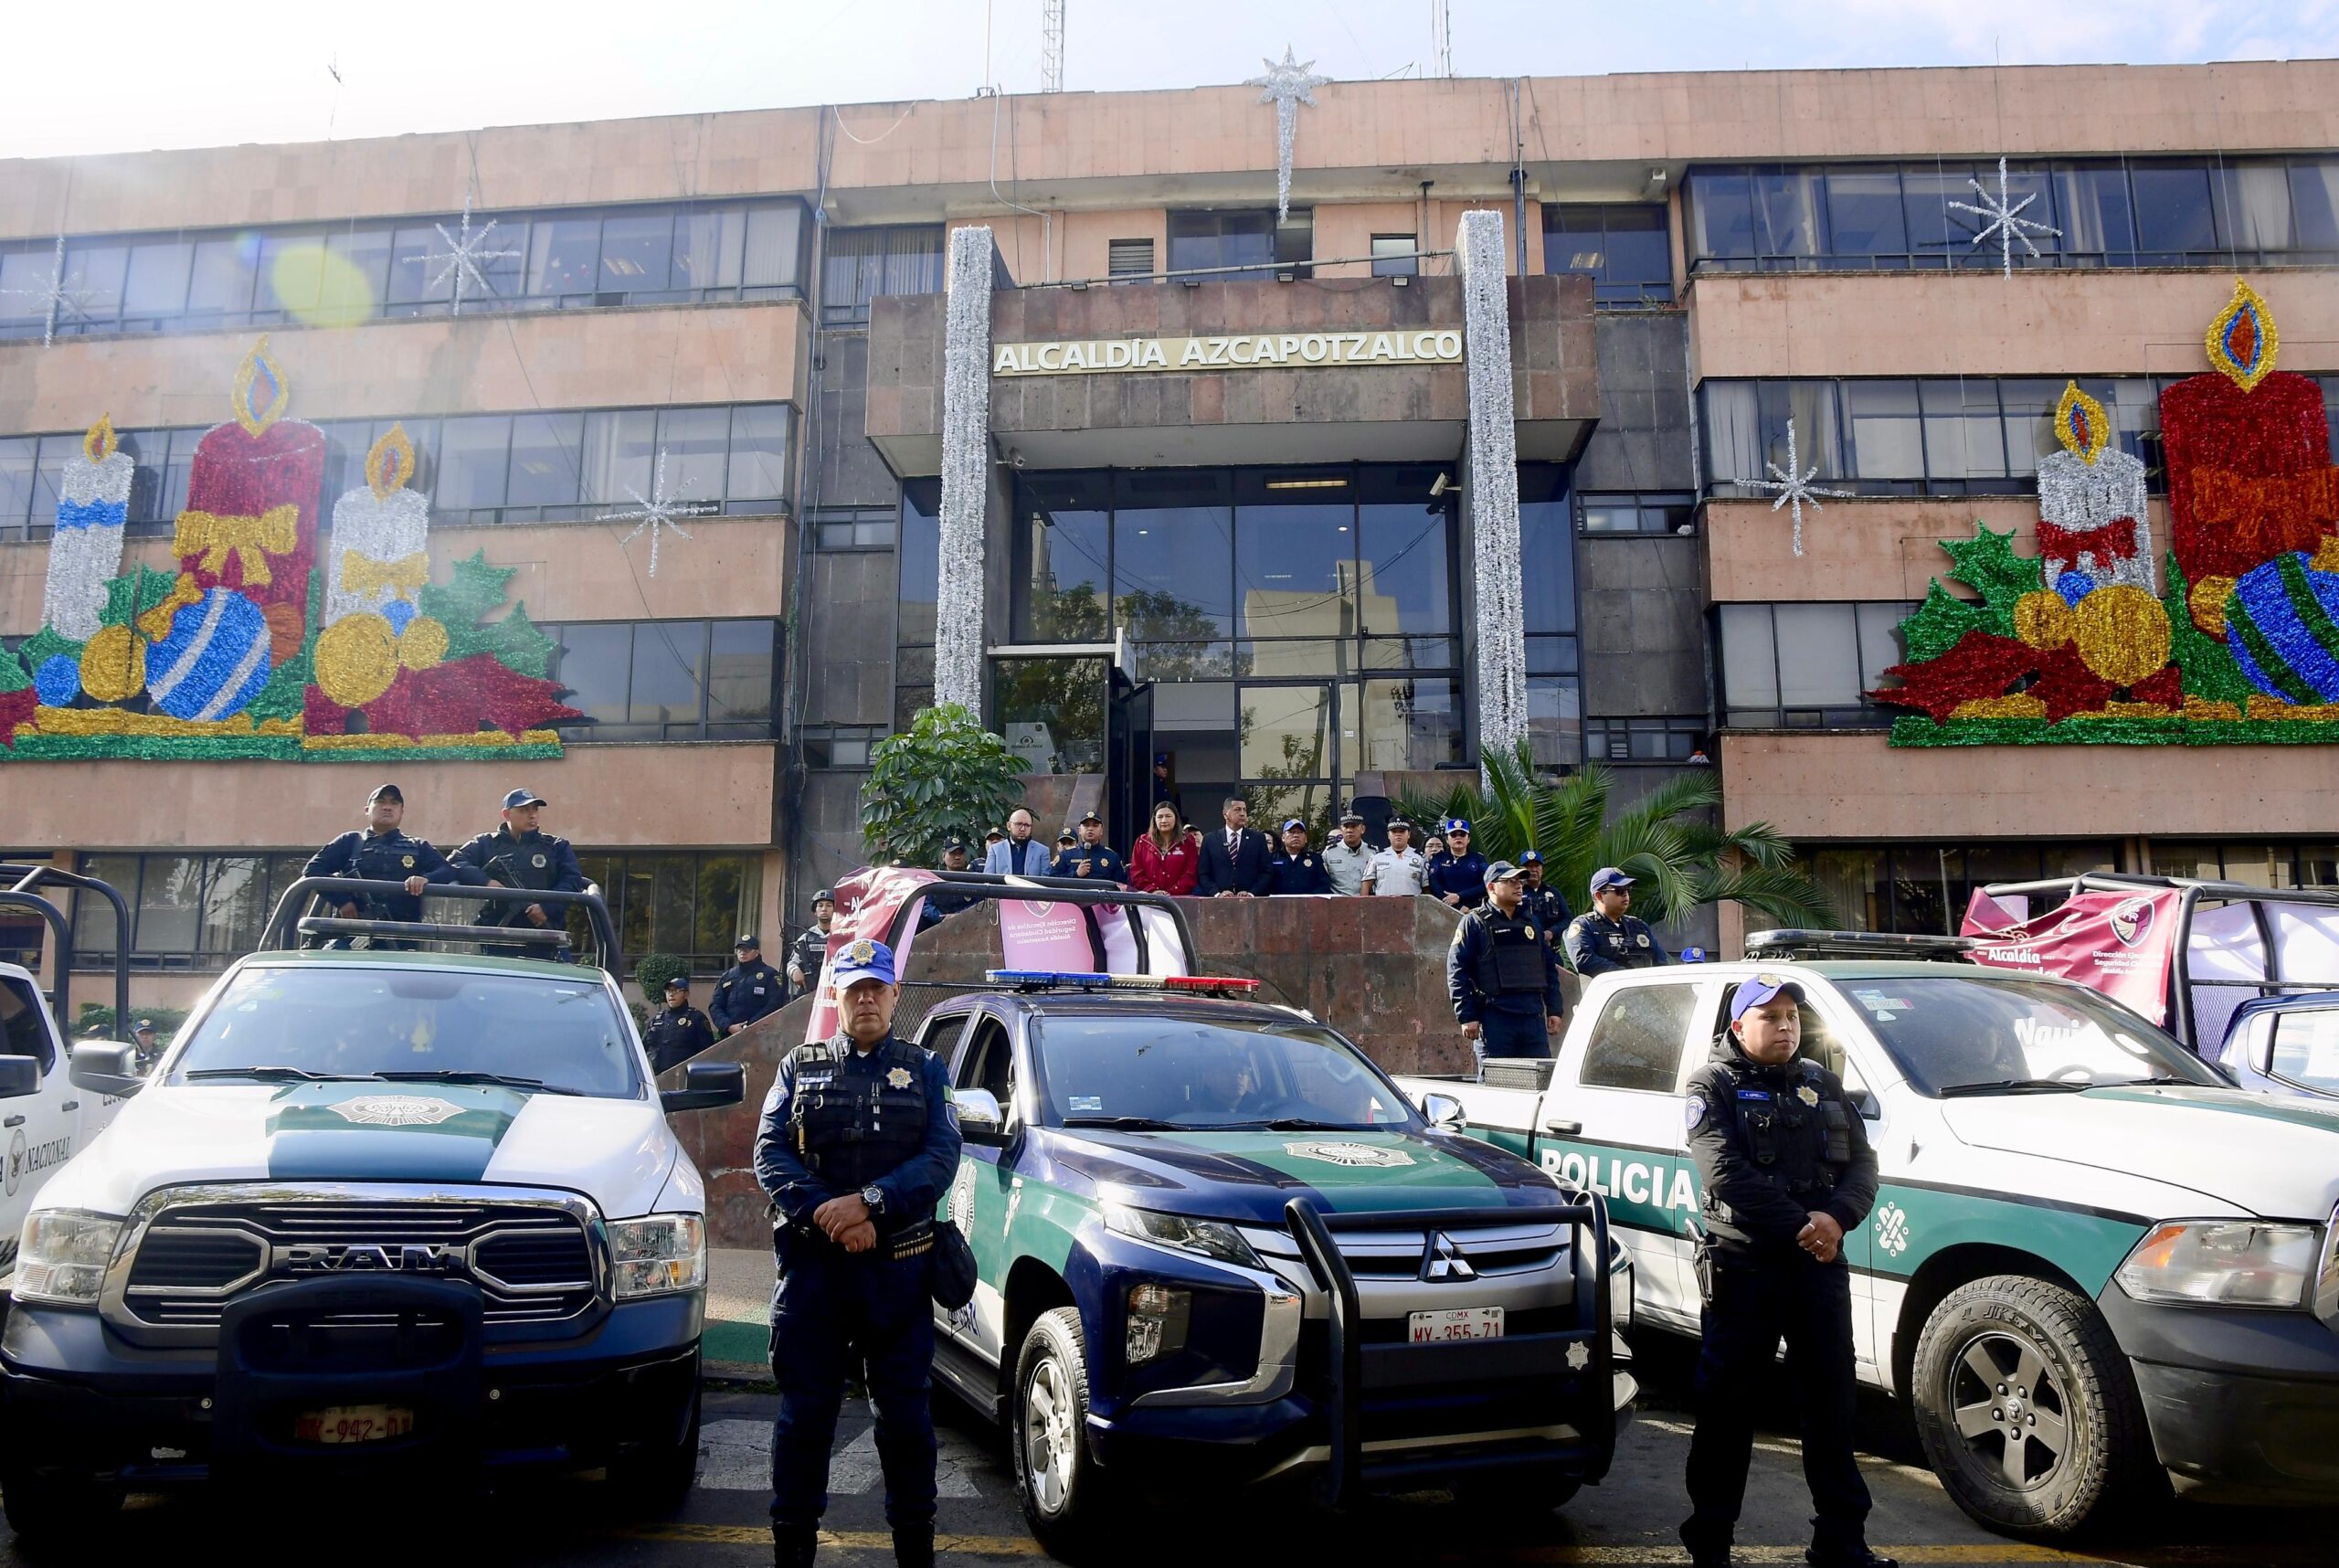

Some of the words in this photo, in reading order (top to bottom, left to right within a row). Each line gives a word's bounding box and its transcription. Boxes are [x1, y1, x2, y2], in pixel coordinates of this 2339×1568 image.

[993, 338, 1168, 373] ALCALDÍA
[1180, 332, 1462, 366] AZCAPOTZALCO
[1988, 948, 2041, 964] Alcaldía
[2092, 950, 2127, 959] Dirección
[2094, 959, 2130, 967] Seguridad
[25, 1136, 70, 1174] NACIONAL
[1541, 1149, 1699, 1213] POLICIA
[272, 1245, 467, 1268] RAM
[1445, 1310, 1469, 1320] CDMX
